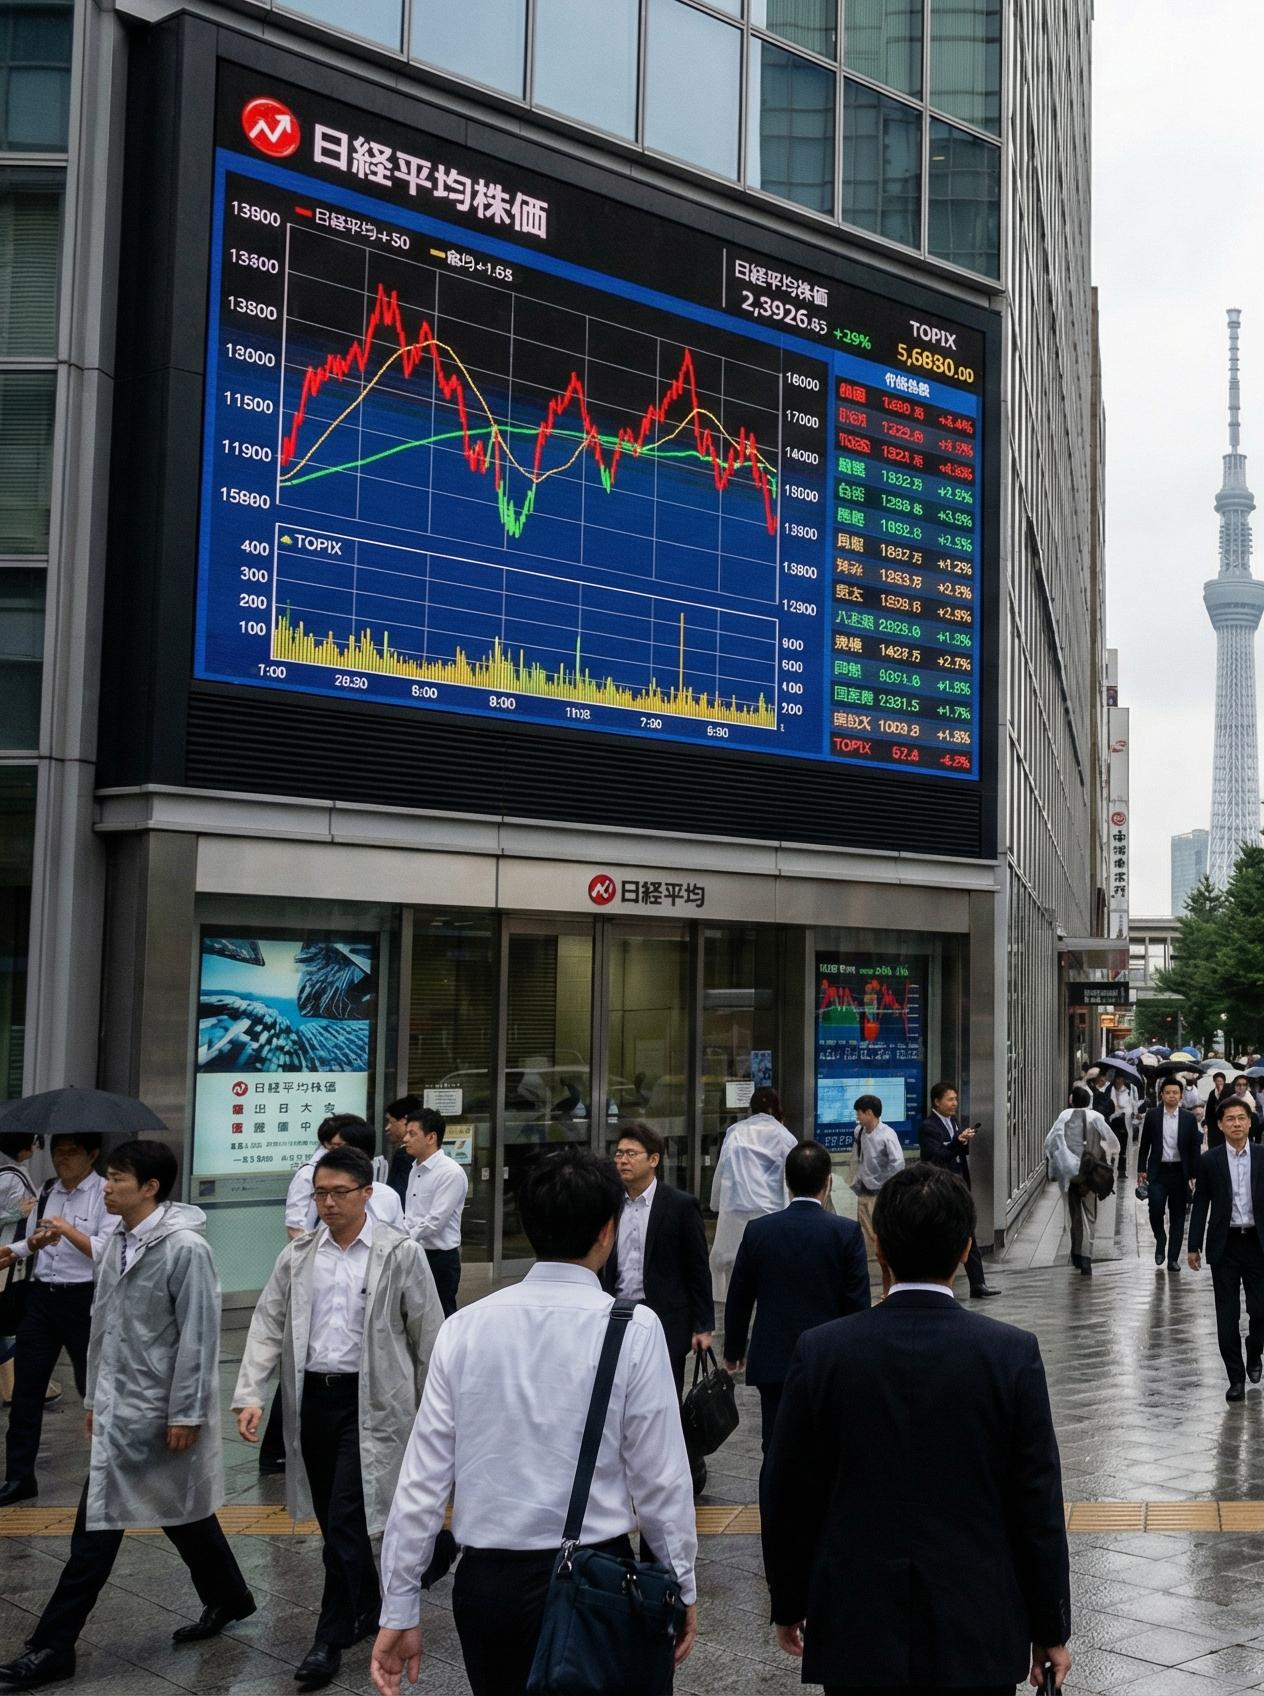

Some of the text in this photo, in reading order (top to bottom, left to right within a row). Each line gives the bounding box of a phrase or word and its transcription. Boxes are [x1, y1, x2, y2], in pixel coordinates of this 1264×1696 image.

[313, 123, 549, 239] 日経平均株価
[909, 320, 957, 350] TOPIX
[224, 391, 273, 414] 11500
[786, 410, 819, 428] 17000
[222, 440, 271, 462] 11900
[785, 447, 819, 464] 14000
[240, 539, 270, 556] 400
[294, 534, 342, 555] TOPIX
[240, 566, 269, 583] 300
[239, 593, 268, 609] 200
[239, 620, 267, 636] 100
[833, 738, 872, 755] TOPIX
[621, 880, 705, 908] 日経平均
